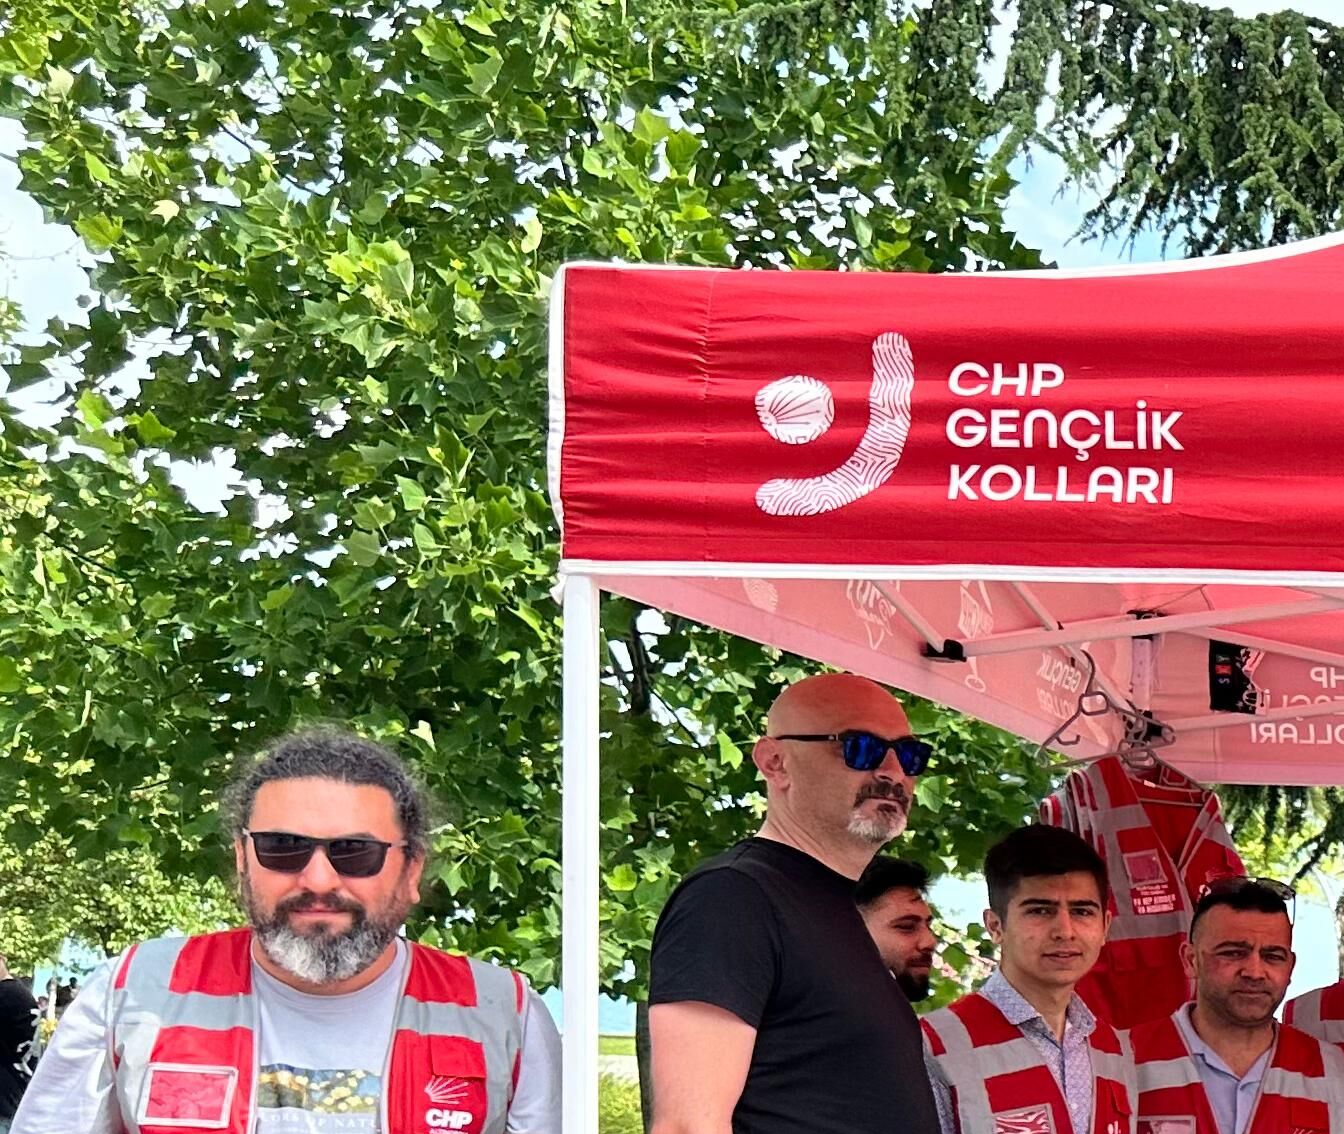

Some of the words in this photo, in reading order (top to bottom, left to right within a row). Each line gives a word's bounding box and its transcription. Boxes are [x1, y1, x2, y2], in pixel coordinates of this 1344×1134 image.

[948, 361, 1065, 397] CHP
[945, 400, 1184, 461] GENÇLİK
[948, 464, 1174, 504] KOLLARI
[426, 1108, 473, 1129] CHP
